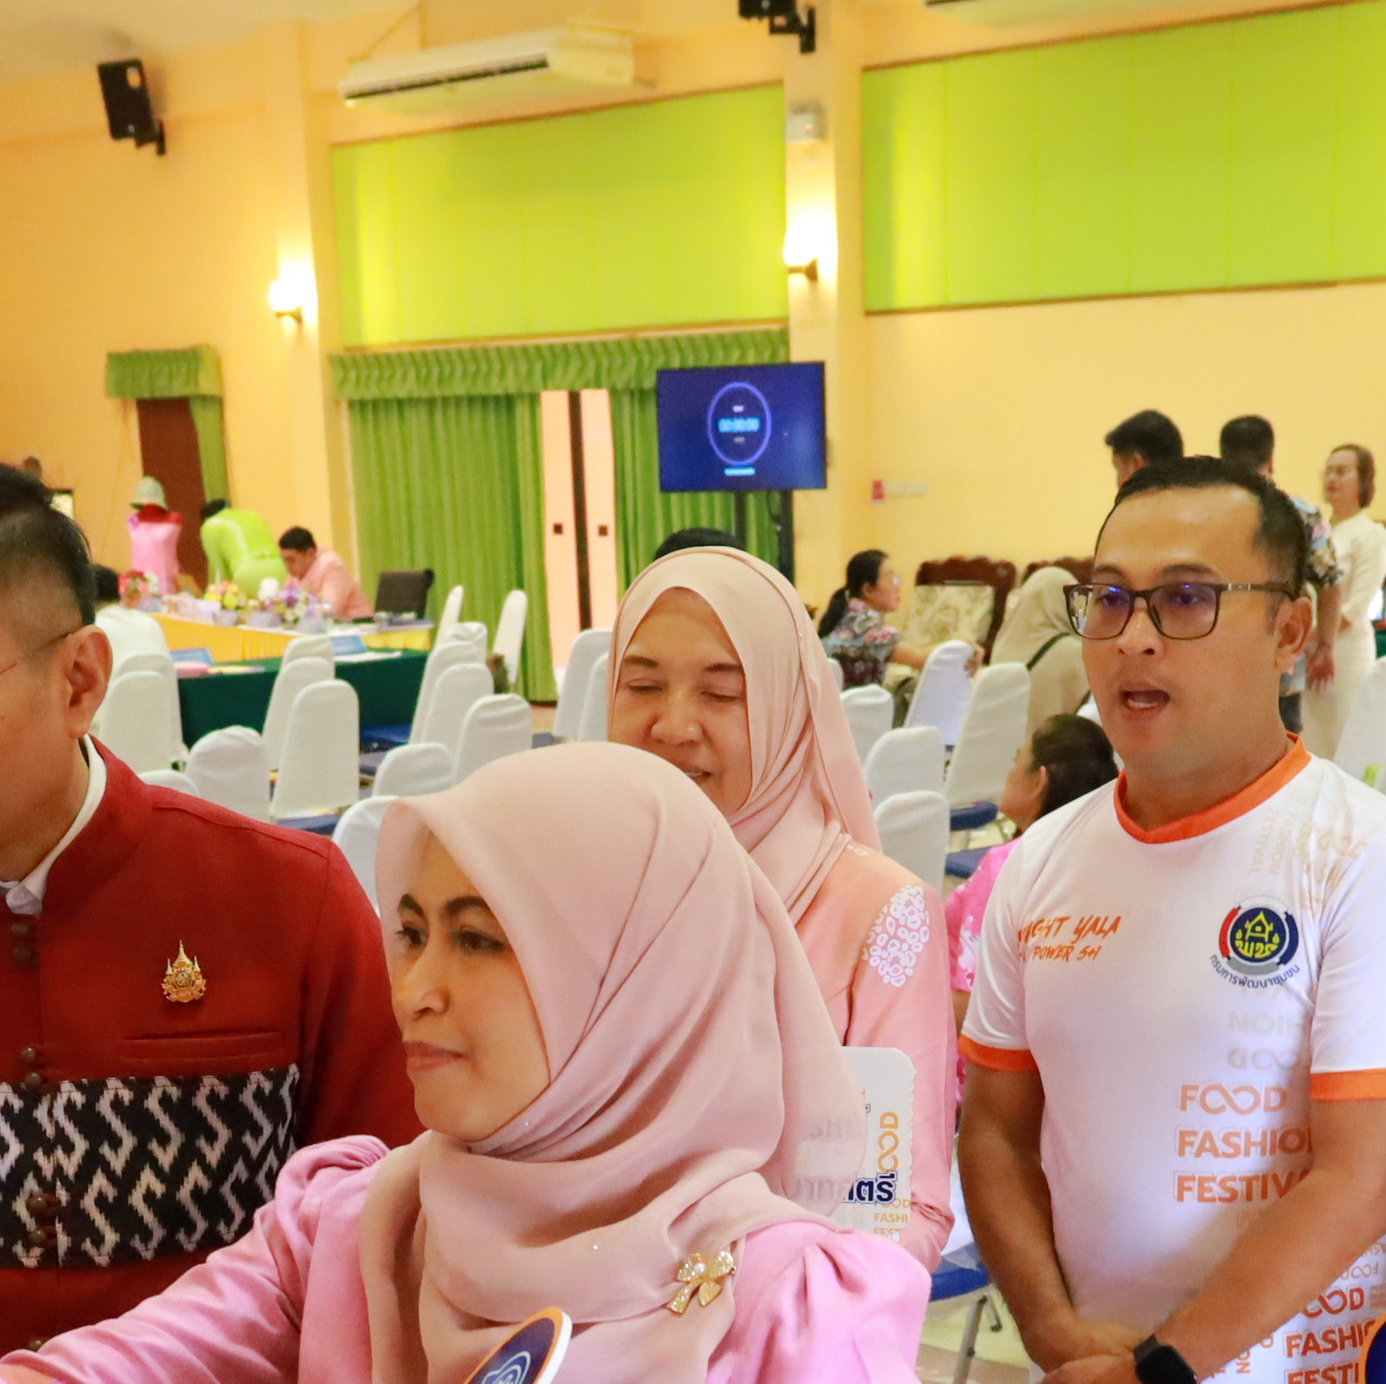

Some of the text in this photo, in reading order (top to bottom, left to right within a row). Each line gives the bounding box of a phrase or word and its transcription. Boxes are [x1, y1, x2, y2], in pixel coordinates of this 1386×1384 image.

[1033, 944, 1075, 962] POWER
[1209, 954, 1301, 989] กรมการพัฒนาชุมชน
[1179, 1084, 1288, 1116] FOOD
